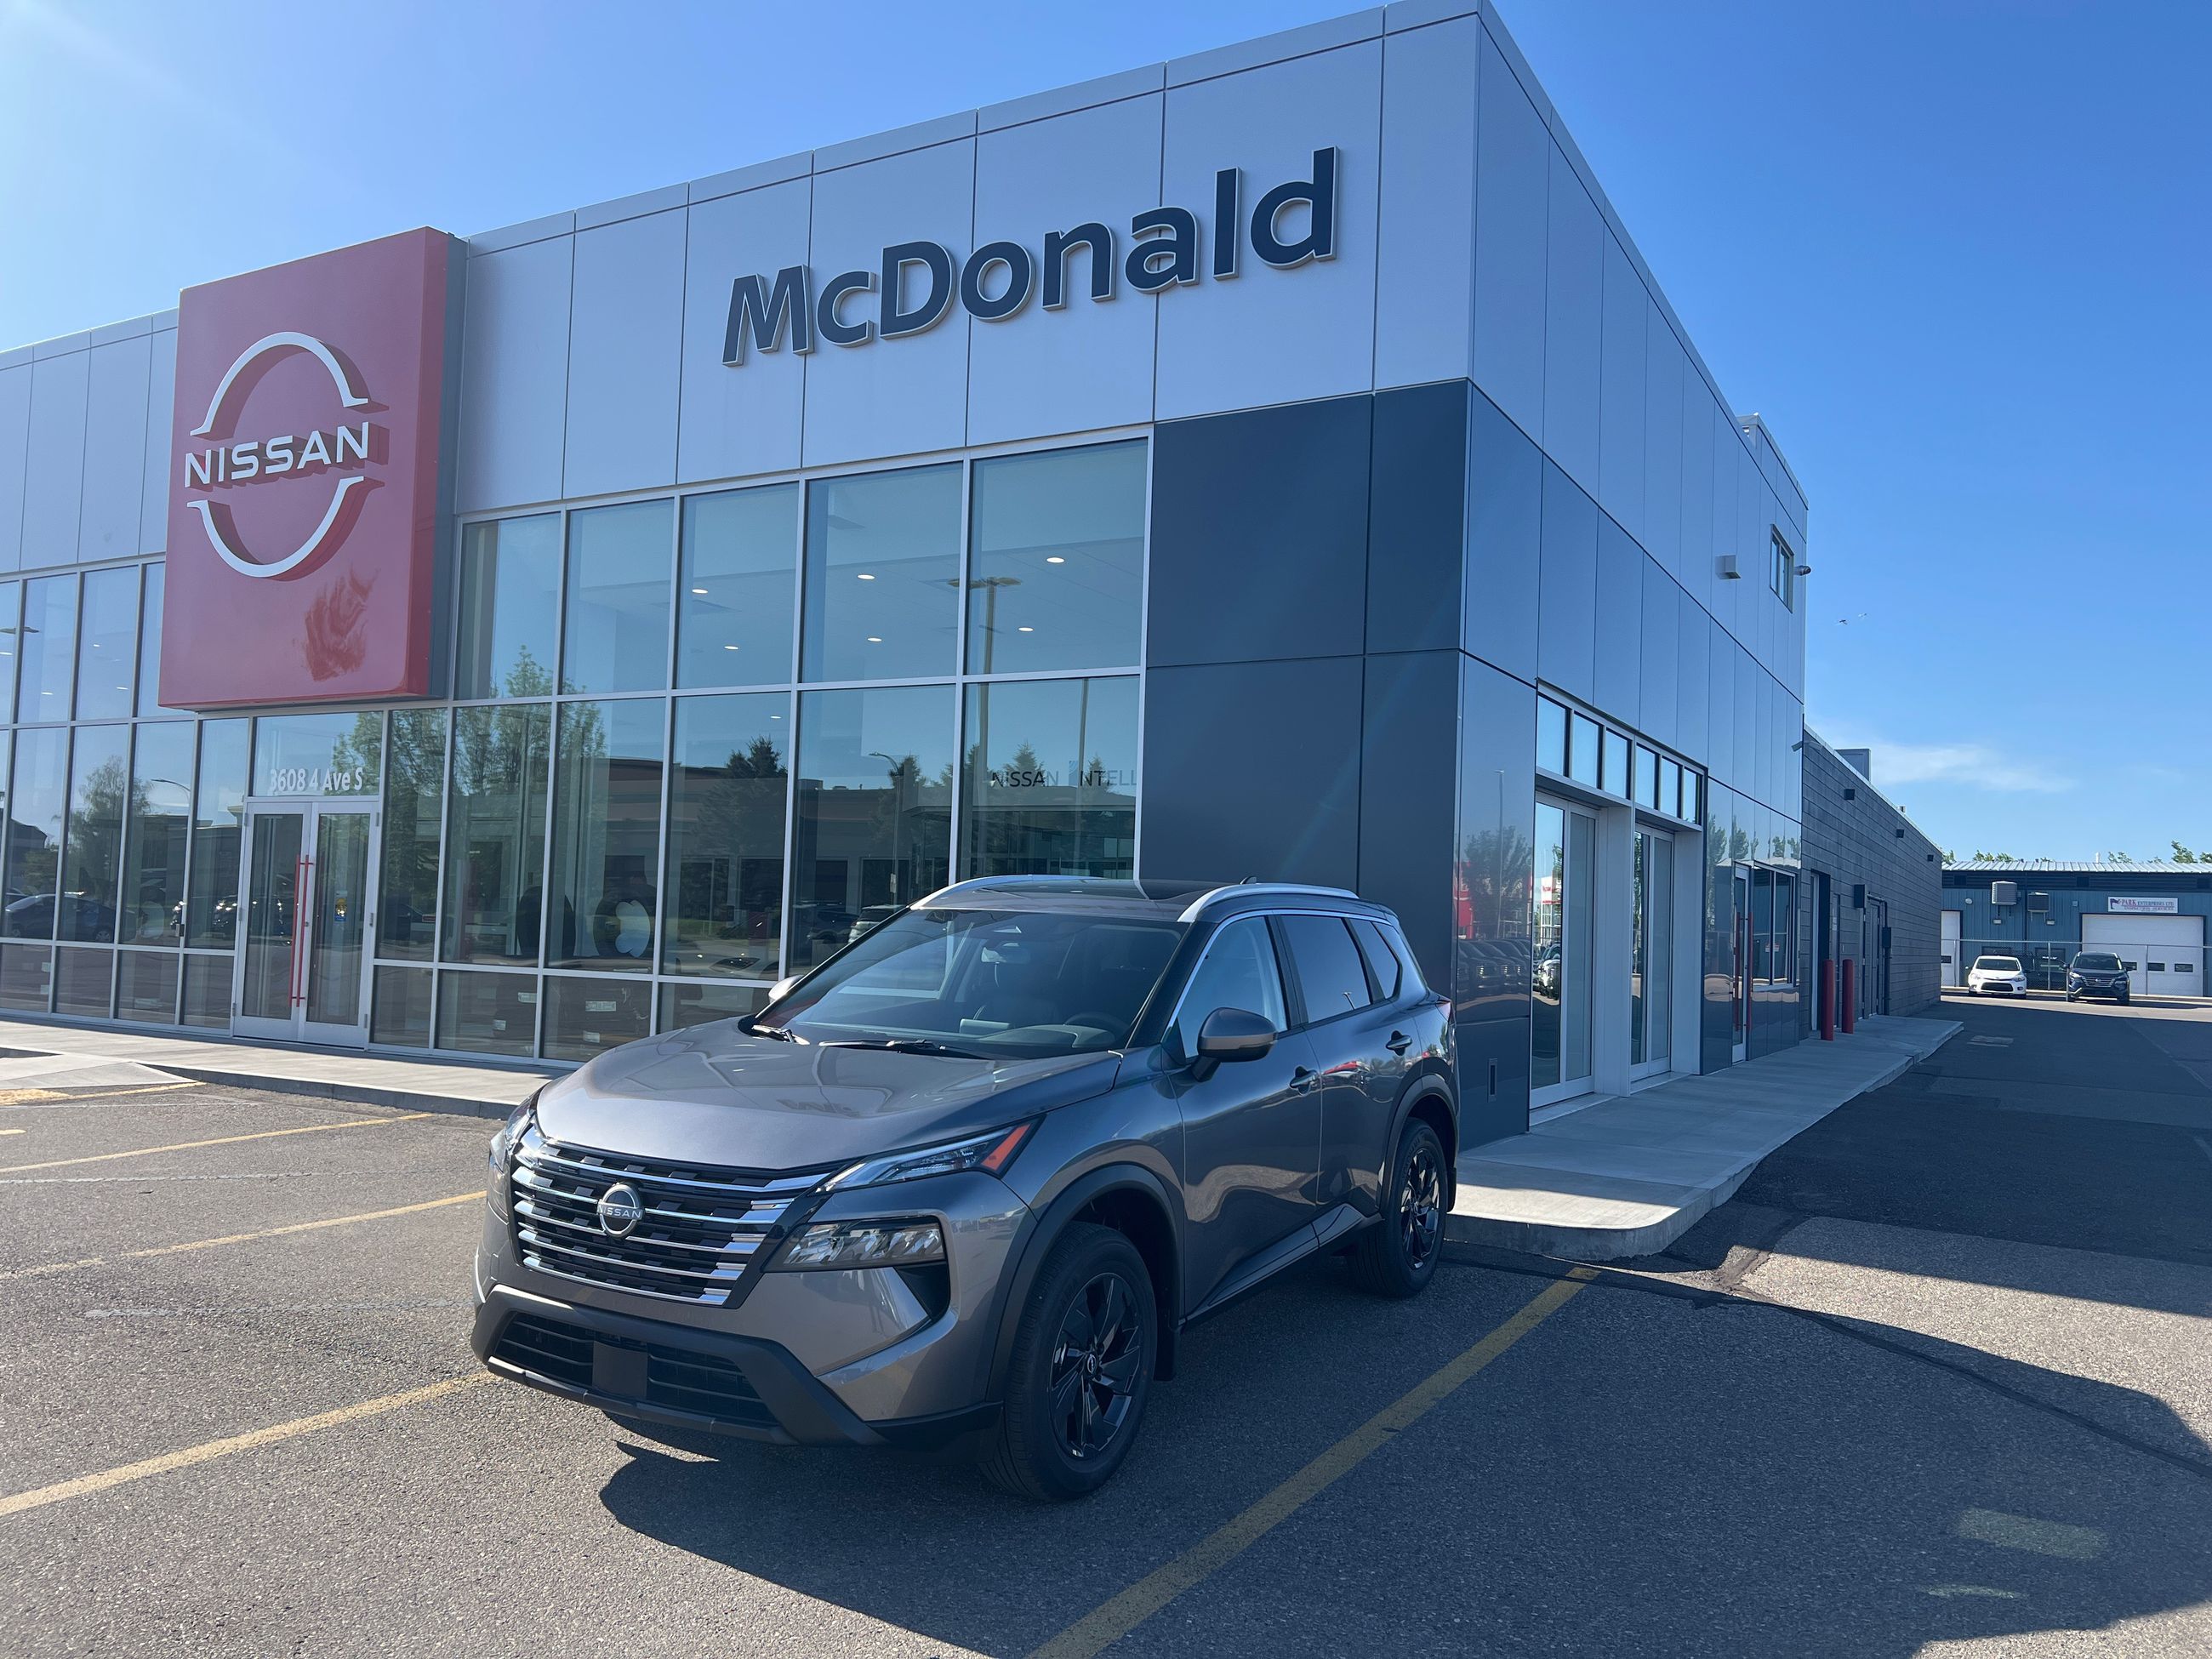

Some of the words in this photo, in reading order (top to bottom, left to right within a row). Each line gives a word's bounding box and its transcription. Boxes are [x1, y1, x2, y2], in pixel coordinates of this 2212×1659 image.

[721, 145, 1340, 368] McDonald
[184, 421, 369, 488] NISSAN
[270, 768, 306, 792] 3608
[309, 768, 319, 791] 4
[322, 768, 351, 791] Ave
[354, 767, 363, 791] S
[992, 770, 1059, 788] NISSAN
[597, 1204, 641, 1218] NISSAN
